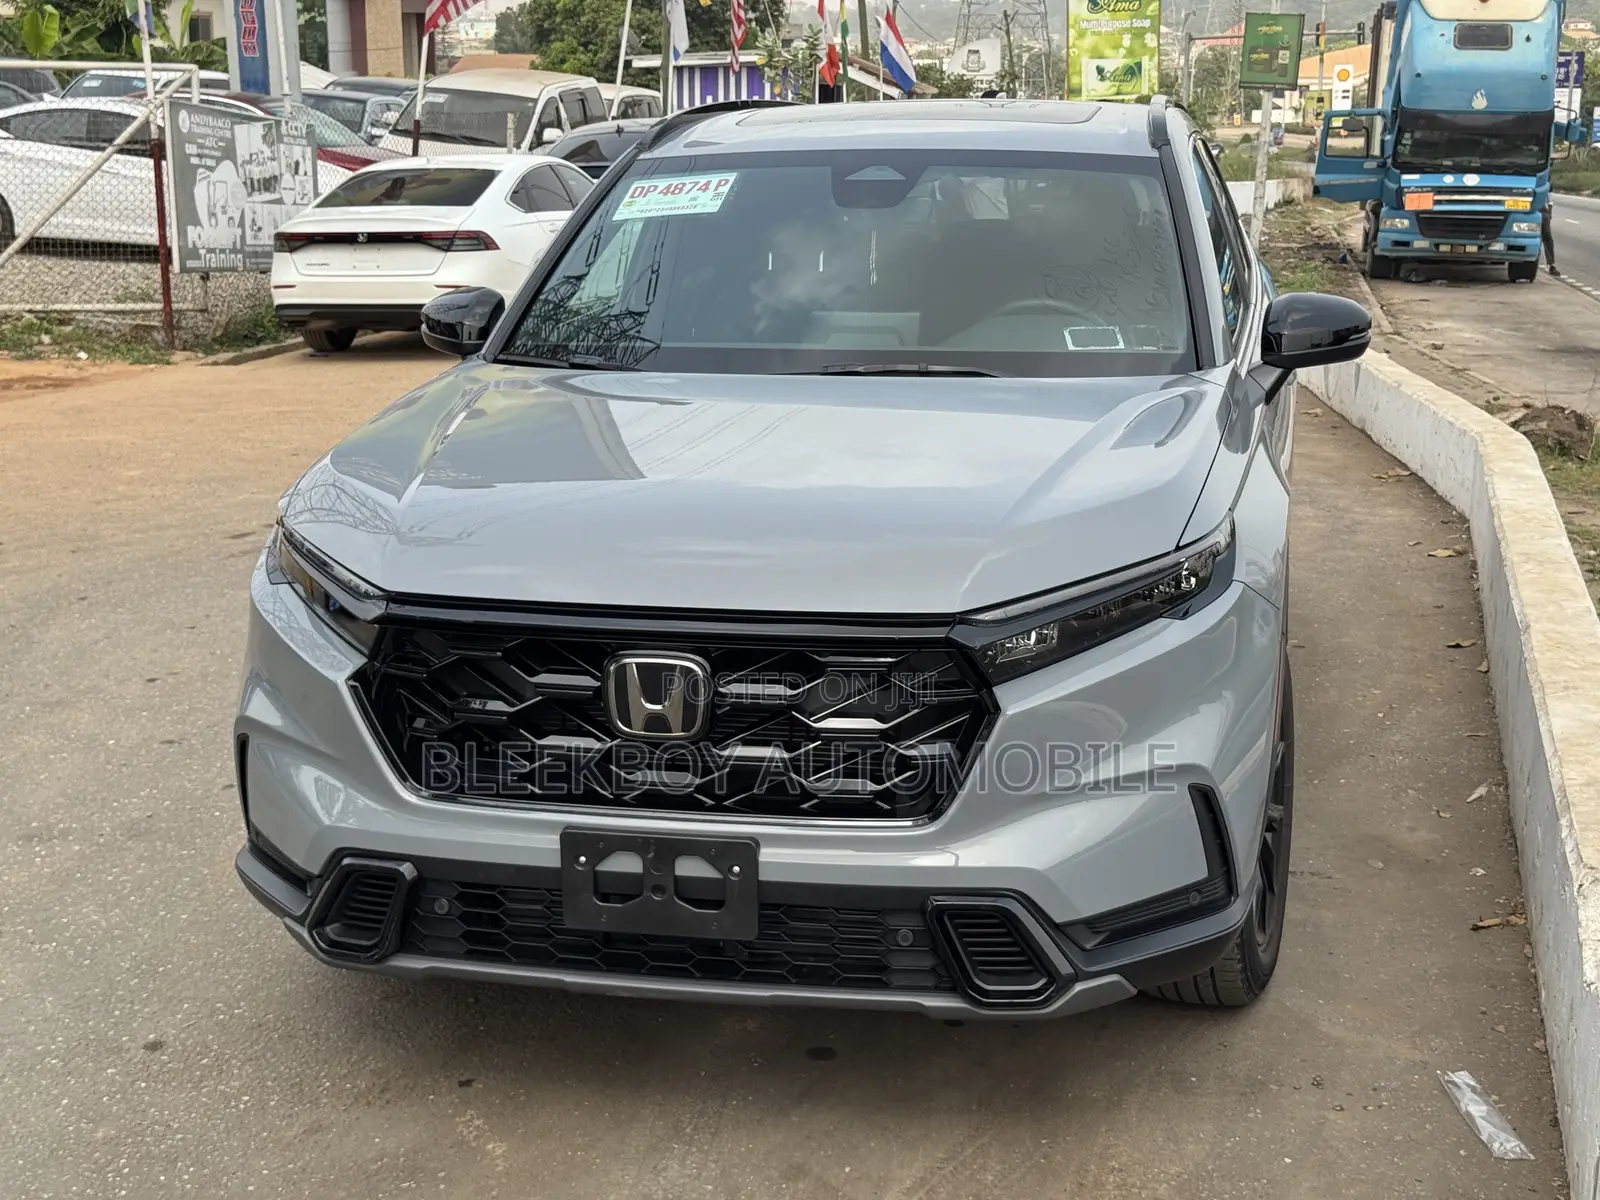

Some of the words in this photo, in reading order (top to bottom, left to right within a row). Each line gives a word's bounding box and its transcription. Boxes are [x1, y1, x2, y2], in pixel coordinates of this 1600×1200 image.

[1132, 18, 1151, 28] Soap
[629, 184, 658, 199] DP
[658, 180, 712, 196] 4874
[713, 178, 730, 191] P
[198, 248, 244, 270] Training
